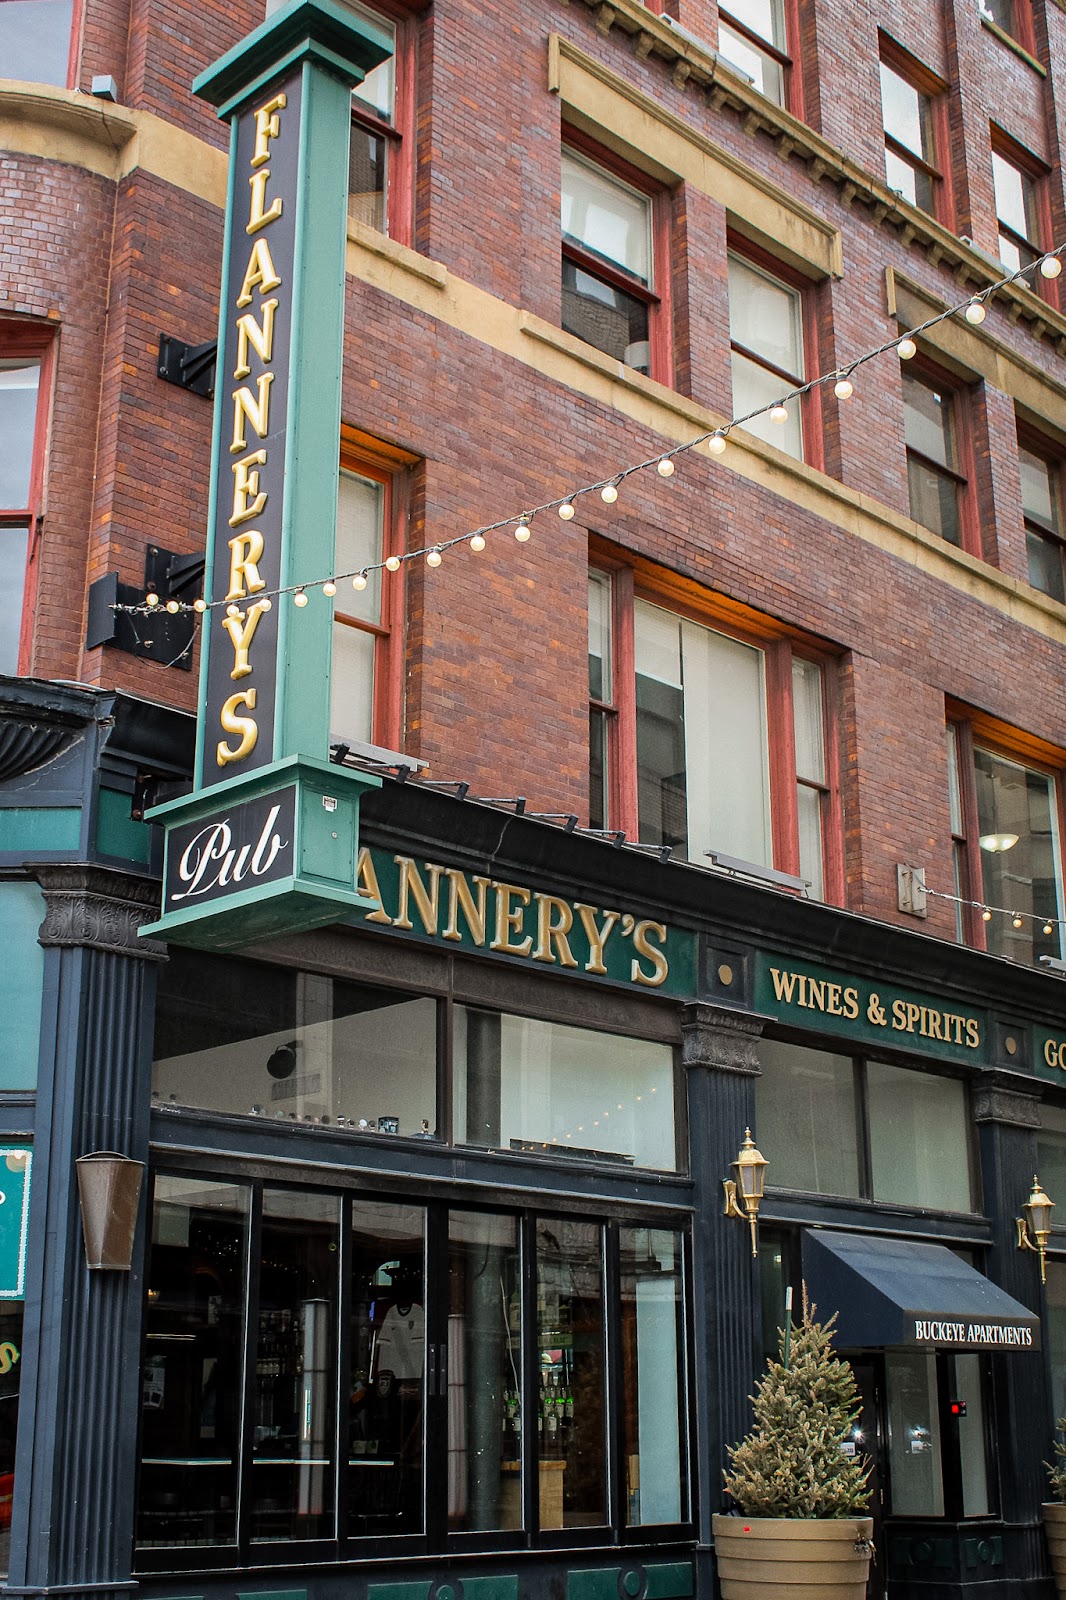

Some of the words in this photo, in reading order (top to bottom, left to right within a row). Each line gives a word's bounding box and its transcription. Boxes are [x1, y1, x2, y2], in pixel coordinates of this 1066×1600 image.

[216, 93, 287, 768] FLANNERYS
[170, 805, 289, 901] Pub
[769, 967, 860, 1019] WINES
[866, 993, 888, 1027] &
[892, 999, 981, 1049] SPIRITS
[914, 1320, 966, 1343] BUCKEYE
[967, 1323, 1033, 1346] APARTMENTS
